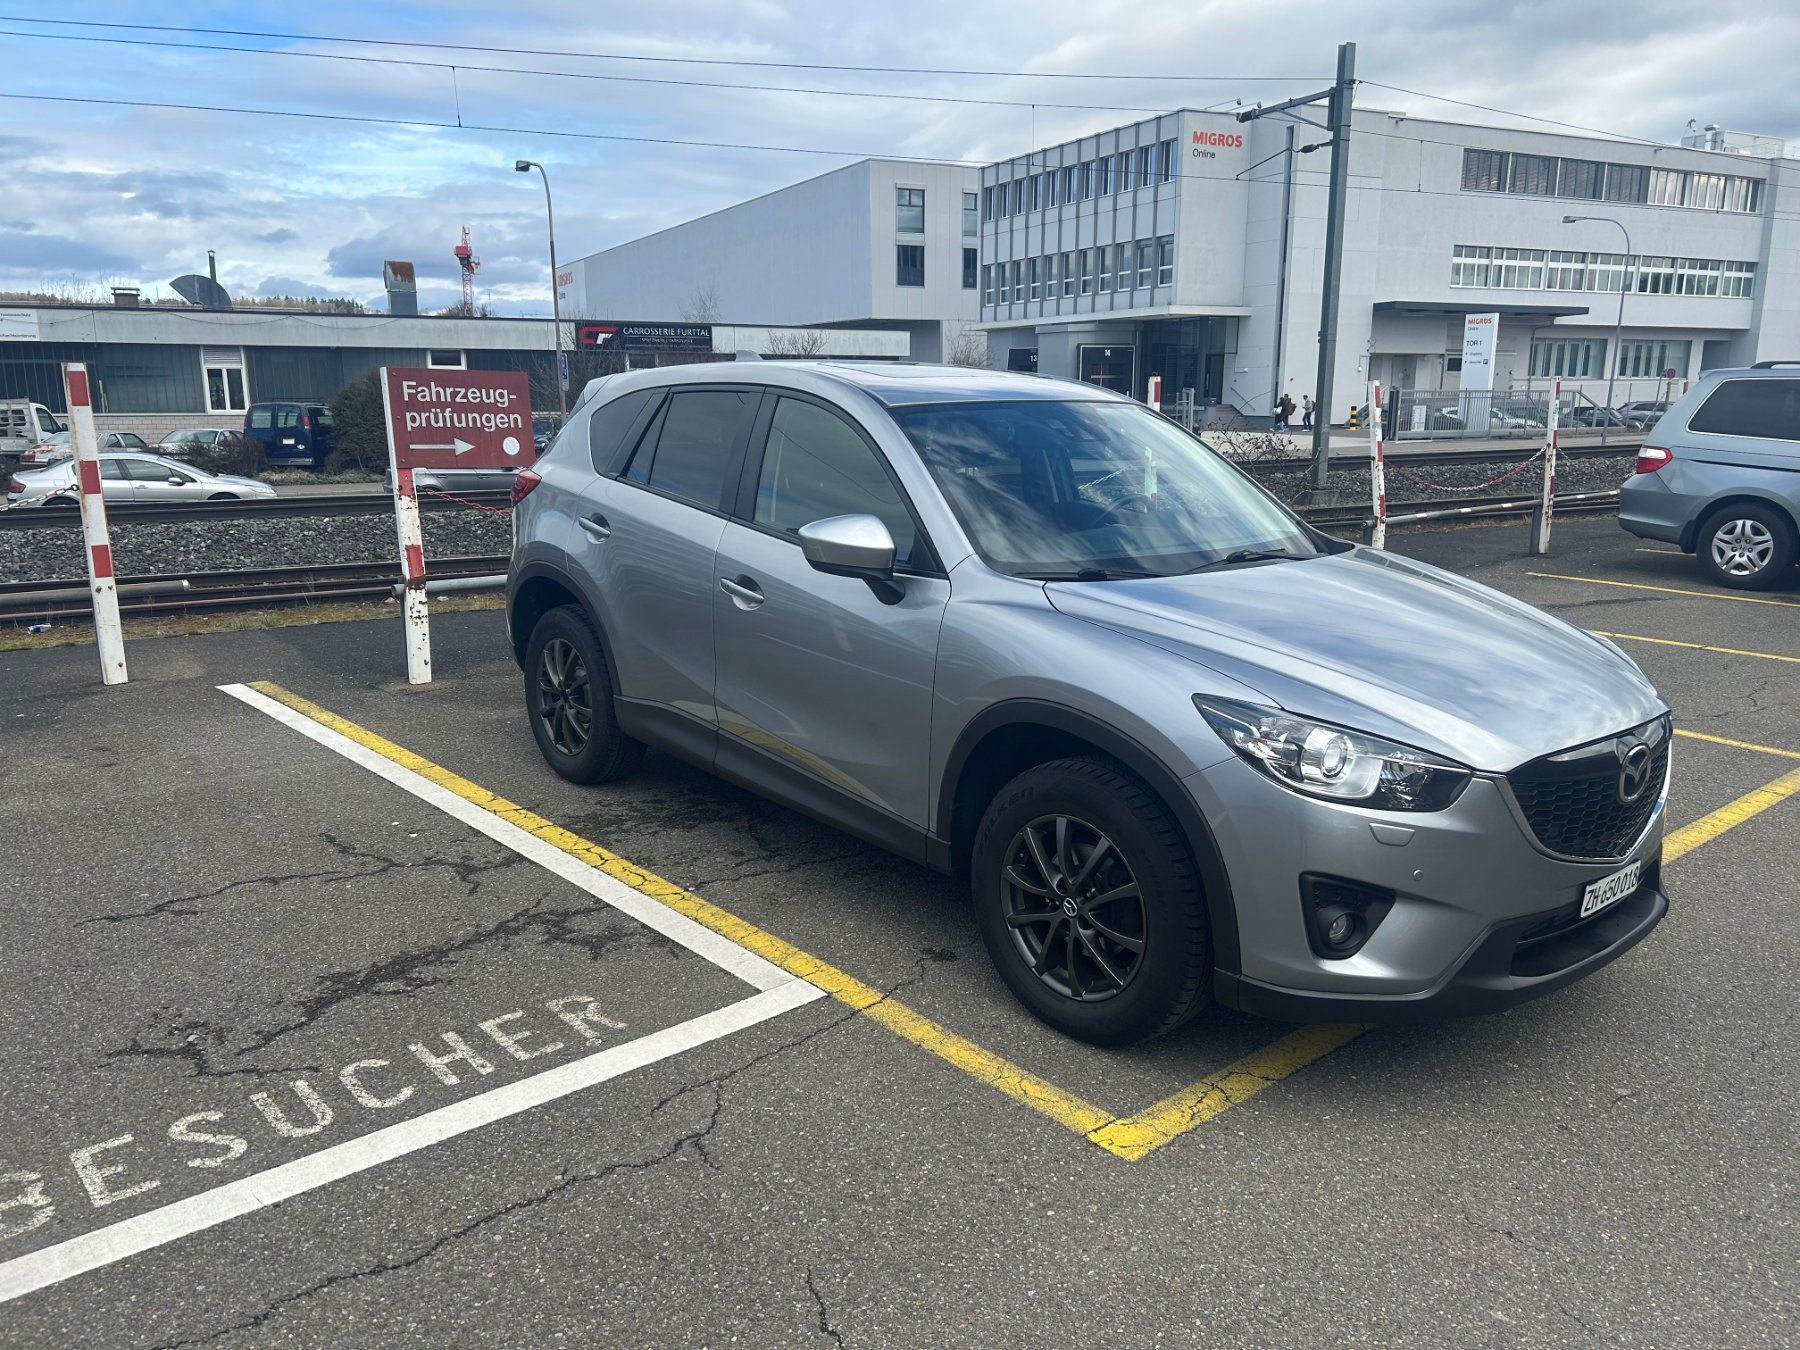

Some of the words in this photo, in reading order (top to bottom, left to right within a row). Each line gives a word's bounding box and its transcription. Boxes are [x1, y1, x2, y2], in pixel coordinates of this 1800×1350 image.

[1192, 130, 1243, 148] MIGROS
[1192, 148, 1216, 159] Online
[622, 327, 675, 336] CARROSSERIE
[677, 328, 710, 337] FURTTAL
[402, 380, 517, 408] Fahrzeug-
[405, 407, 523, 432] prüfungen
[0, 994, 629, 1240] BESUCHER
